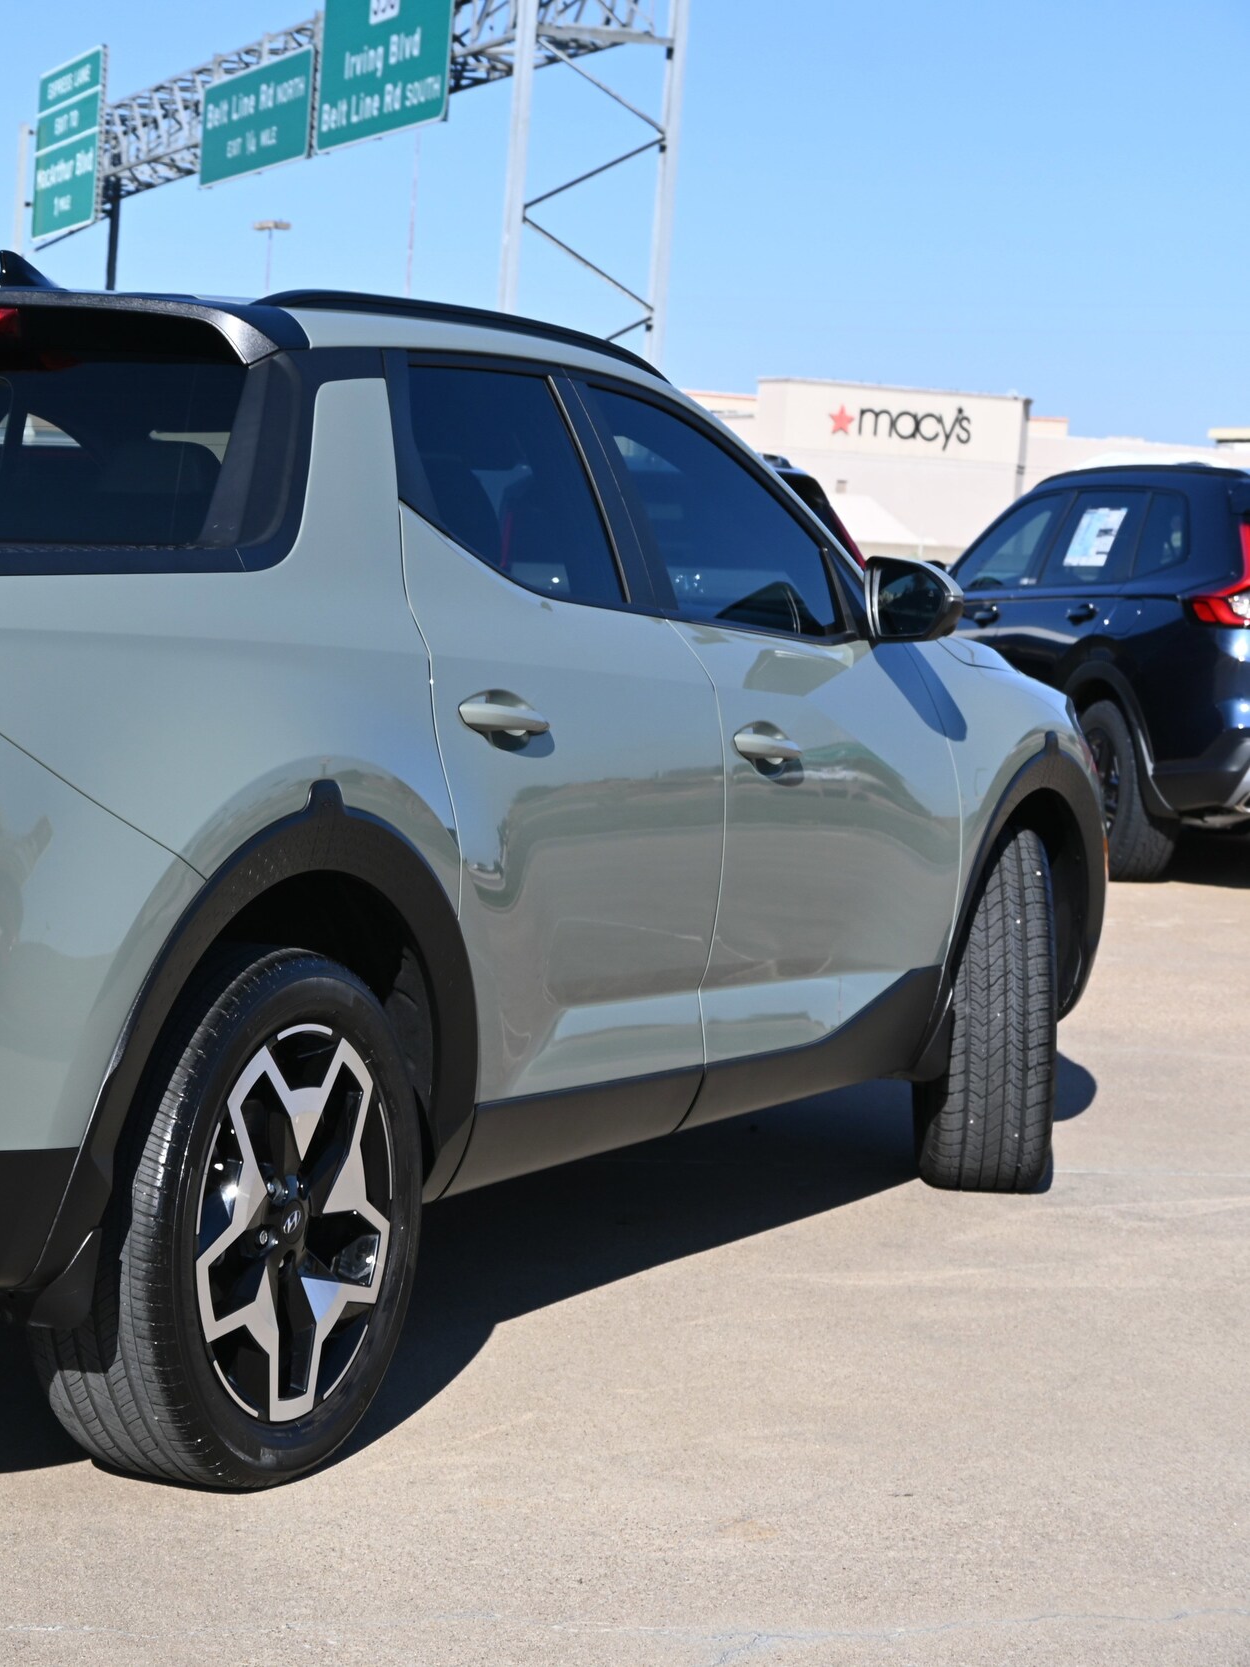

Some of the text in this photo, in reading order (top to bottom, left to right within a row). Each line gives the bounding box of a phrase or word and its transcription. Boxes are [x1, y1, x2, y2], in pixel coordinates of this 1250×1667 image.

[344, 26, 421, 80] Irving Blvd
[206, 75, 306, 129] Belt Line Rd NORTH
[321, 75, 441, 132] Belt Line Rd SOUTH
[226, 137, 243, 158] EXIT
[260, 125, 277, 147] MILE
[858, 406, 971, 452] macy's
